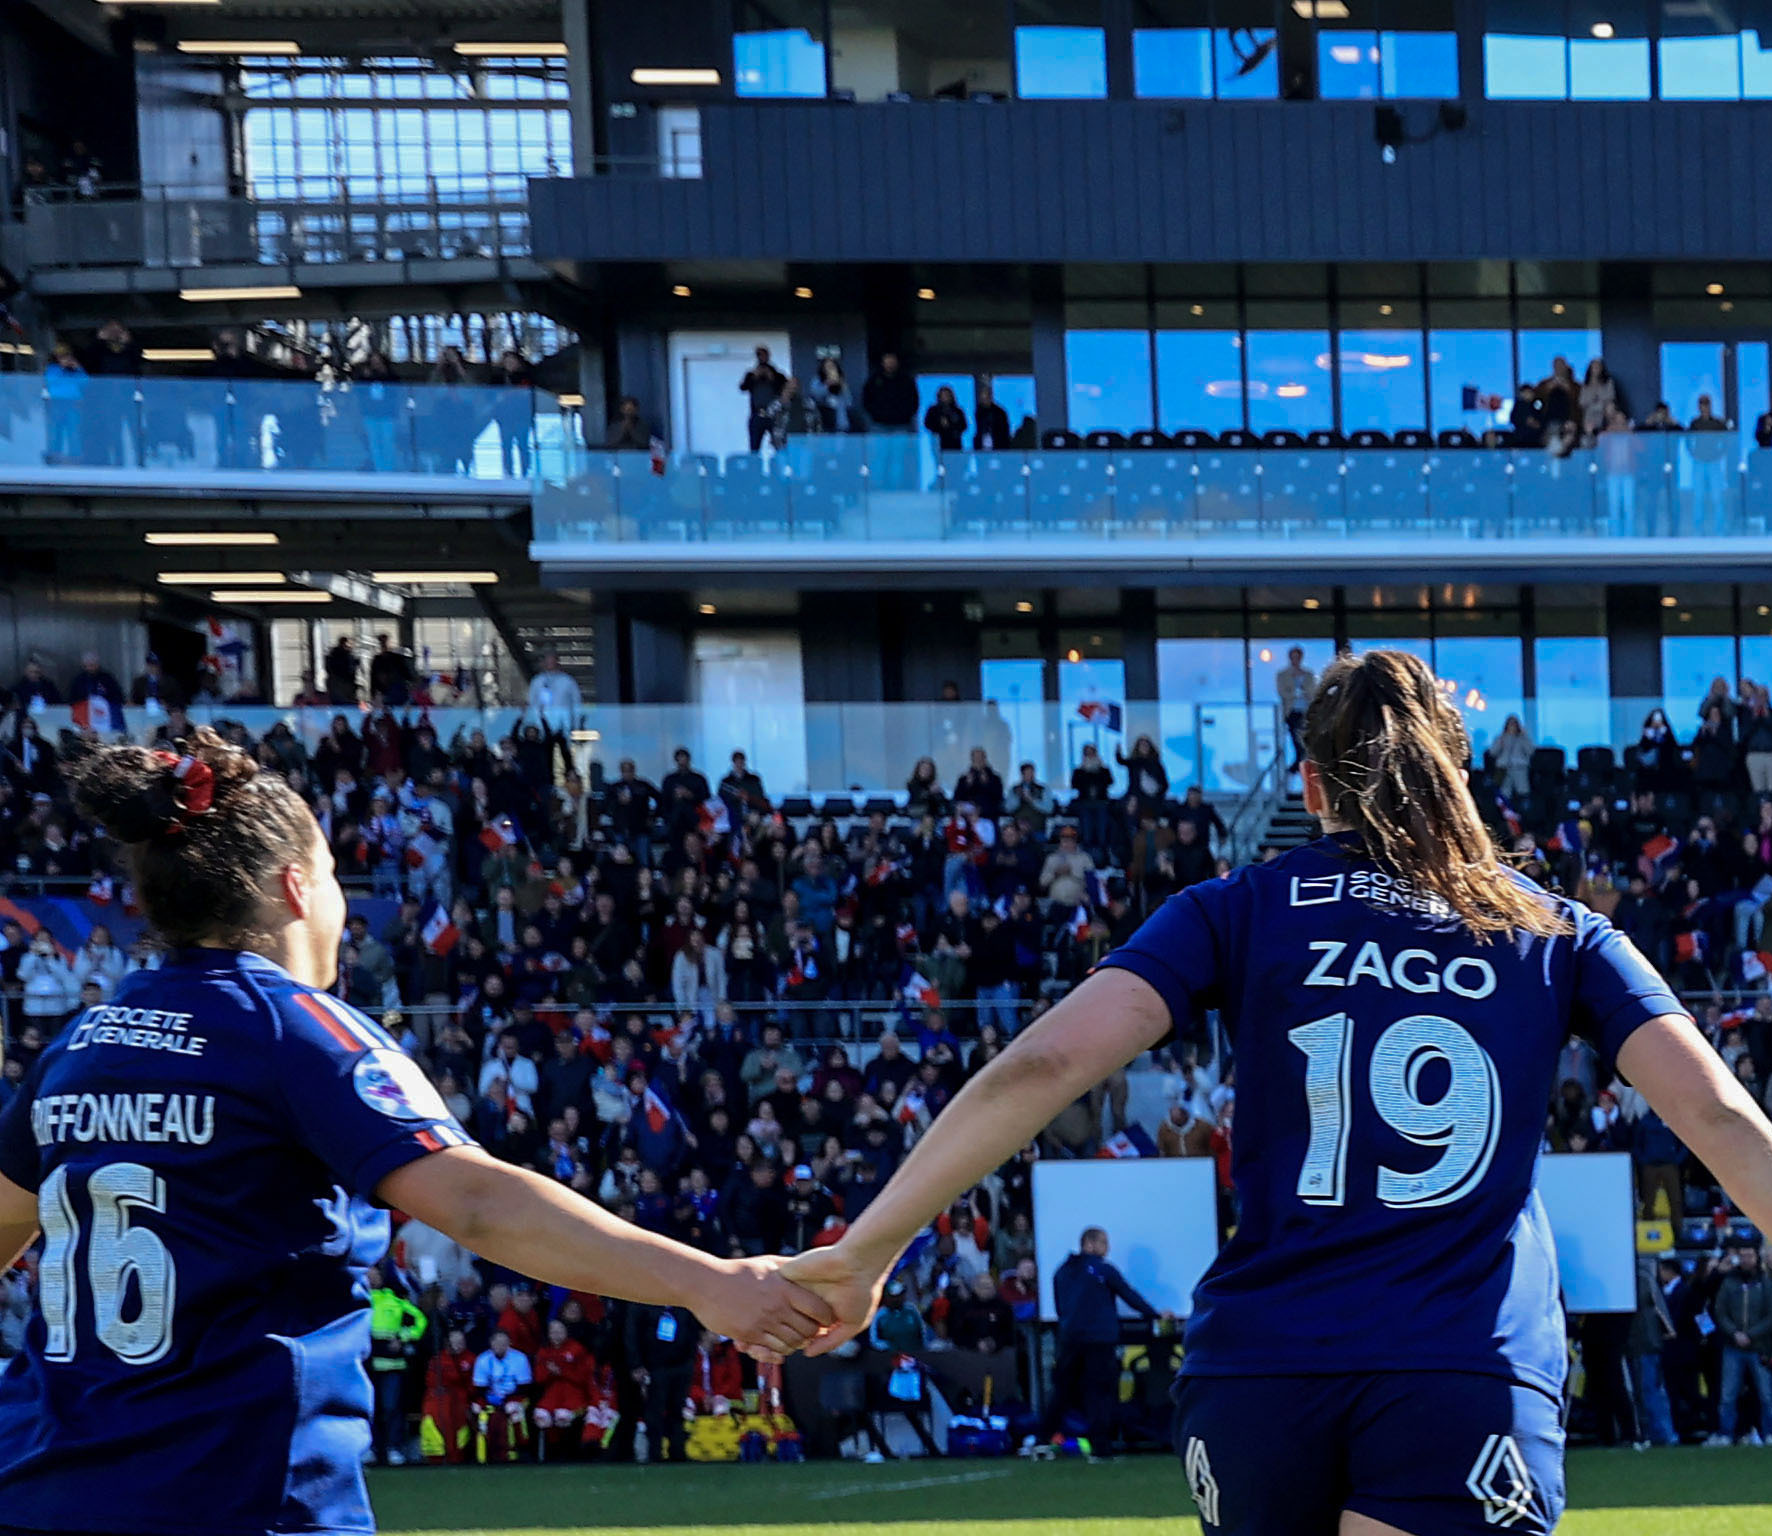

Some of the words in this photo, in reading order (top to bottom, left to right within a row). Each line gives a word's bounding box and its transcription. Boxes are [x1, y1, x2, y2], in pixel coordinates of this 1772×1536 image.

[1303, 941, 1498, 1000] ZAGO
[1287, 1012, 1502, 1209] 19
[38, 1161, 177, 1366] 16
